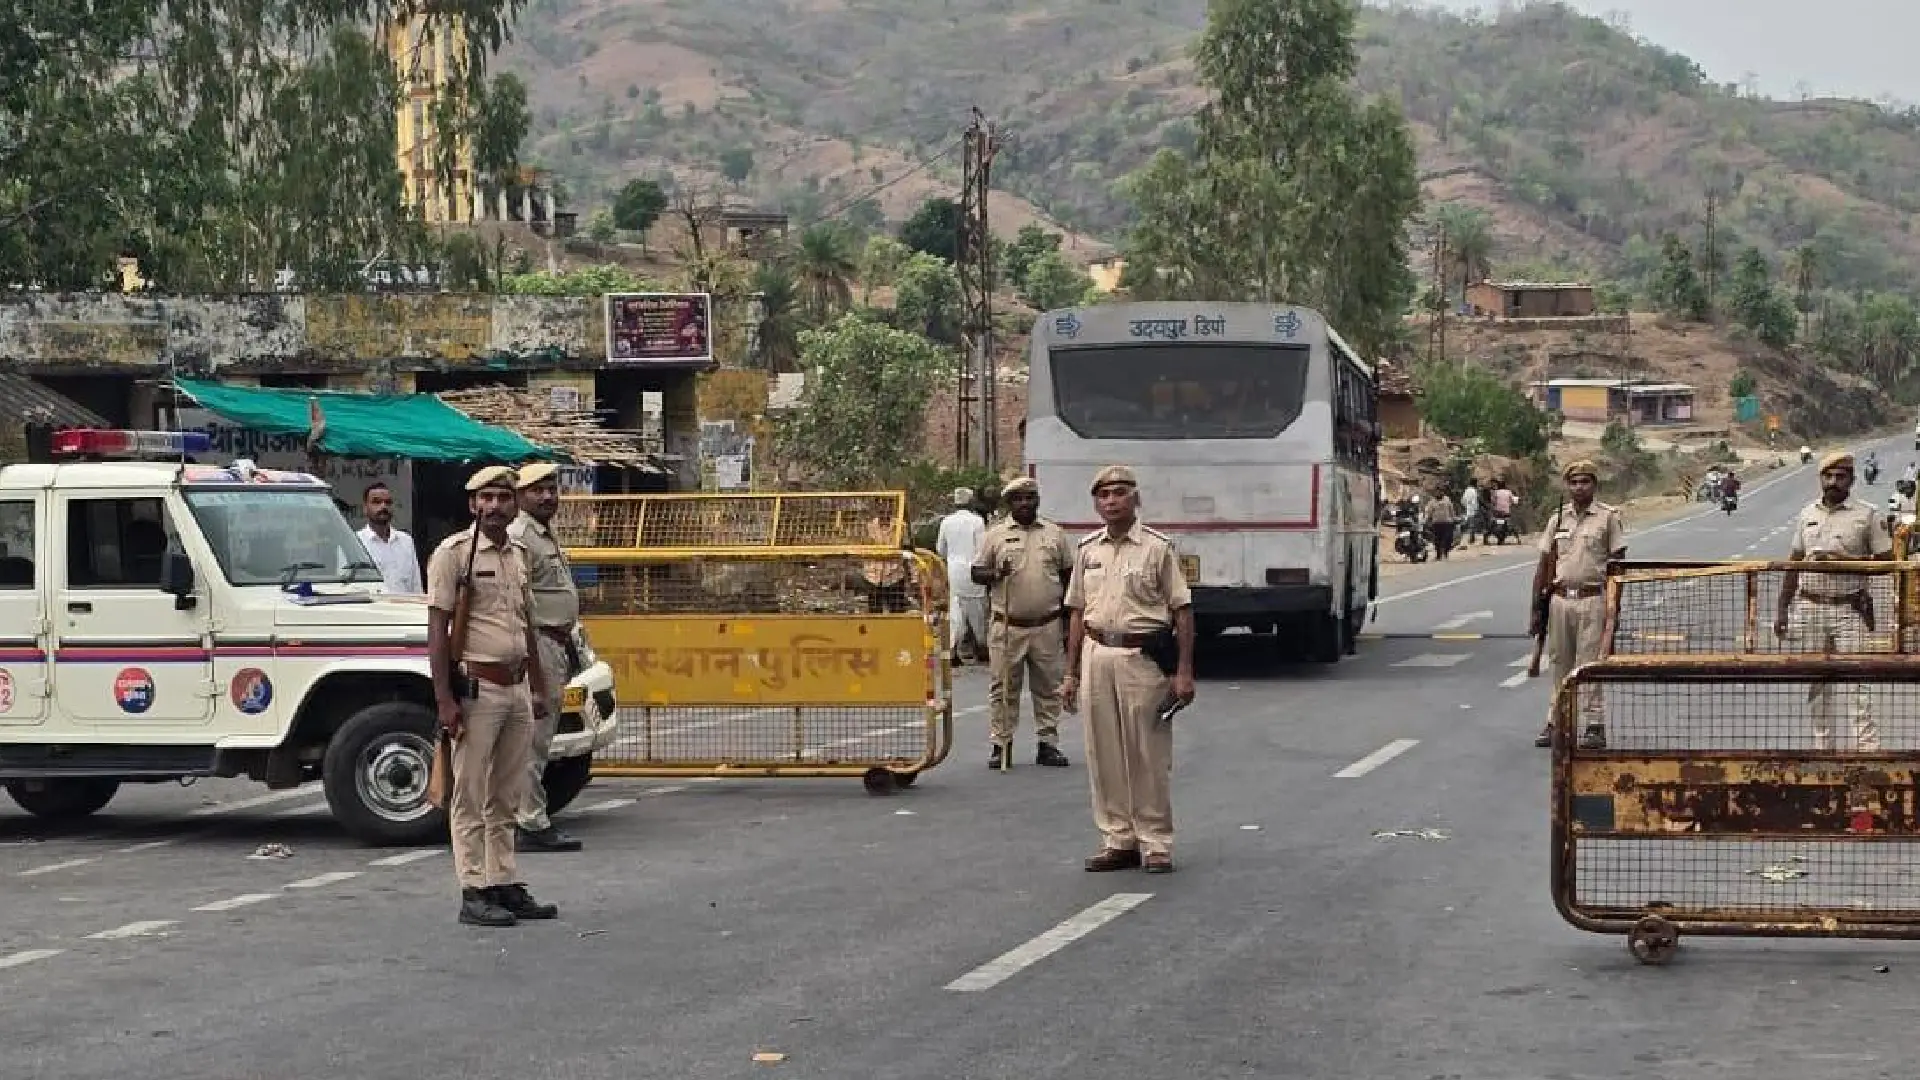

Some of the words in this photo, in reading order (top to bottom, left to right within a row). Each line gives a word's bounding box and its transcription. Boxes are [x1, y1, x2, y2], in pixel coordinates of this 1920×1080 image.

[1129, 319, 1187, 340] उदयपुर
[1194, 314, 1226, 338] डिपो
[757, 634, 882, 690] पुलिस
